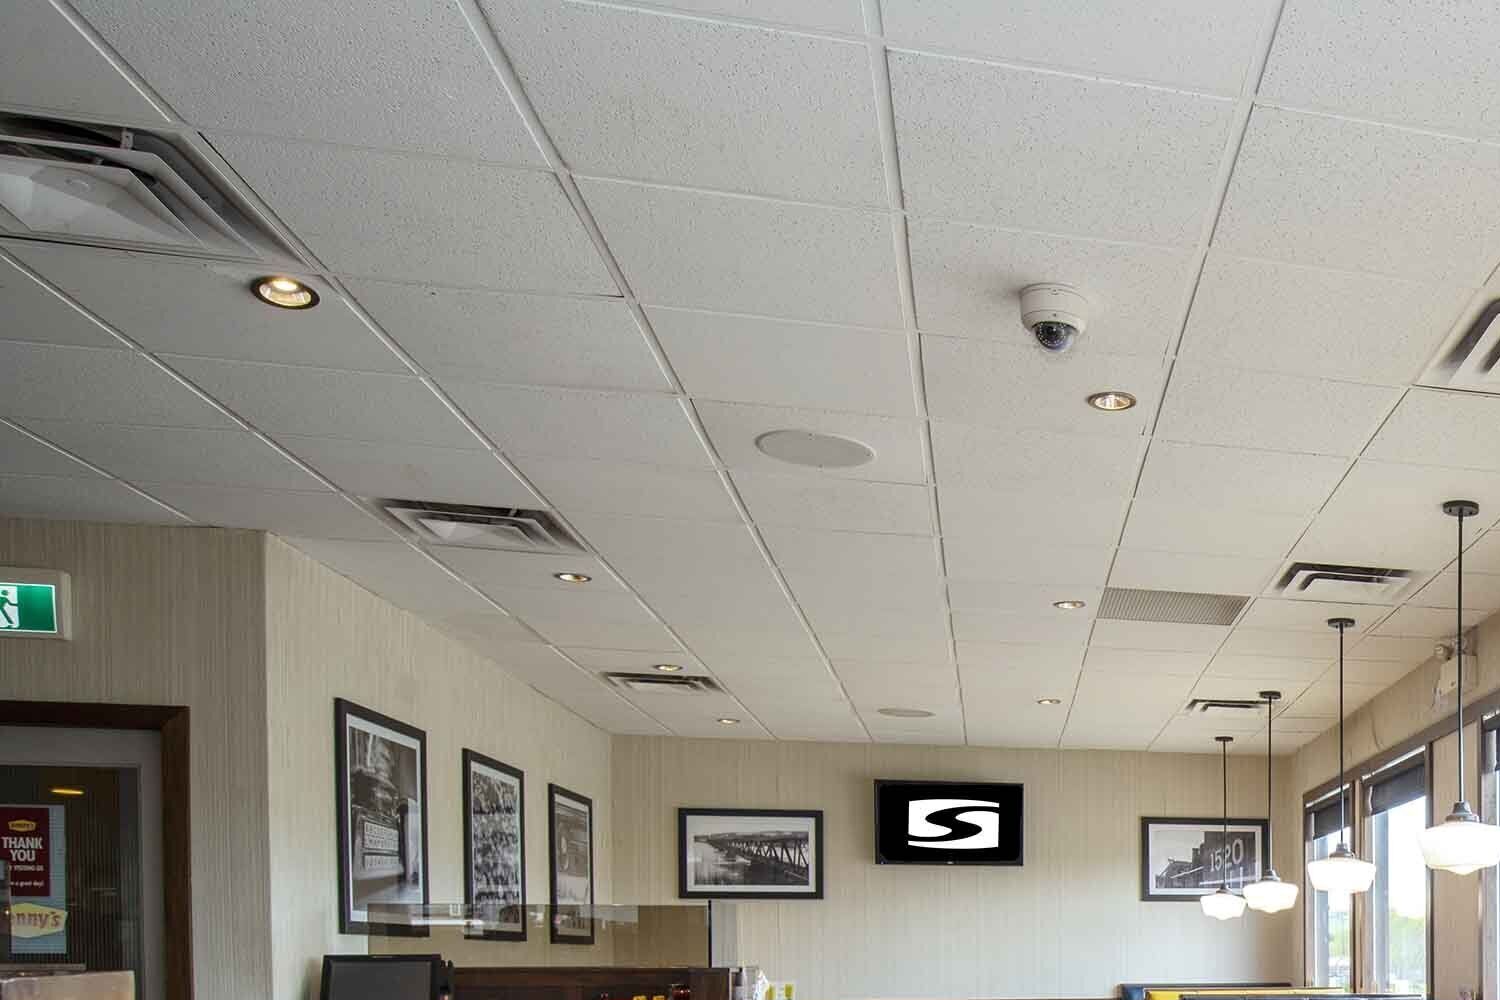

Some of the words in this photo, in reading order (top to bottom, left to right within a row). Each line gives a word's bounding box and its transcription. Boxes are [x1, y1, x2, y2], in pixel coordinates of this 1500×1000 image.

[2, 836, 43, 849] THANK
[10, 849, 36, 861] YOU
[1210, 838, 1244, 872] 1520
[12, 911, 60, 930] nny's
